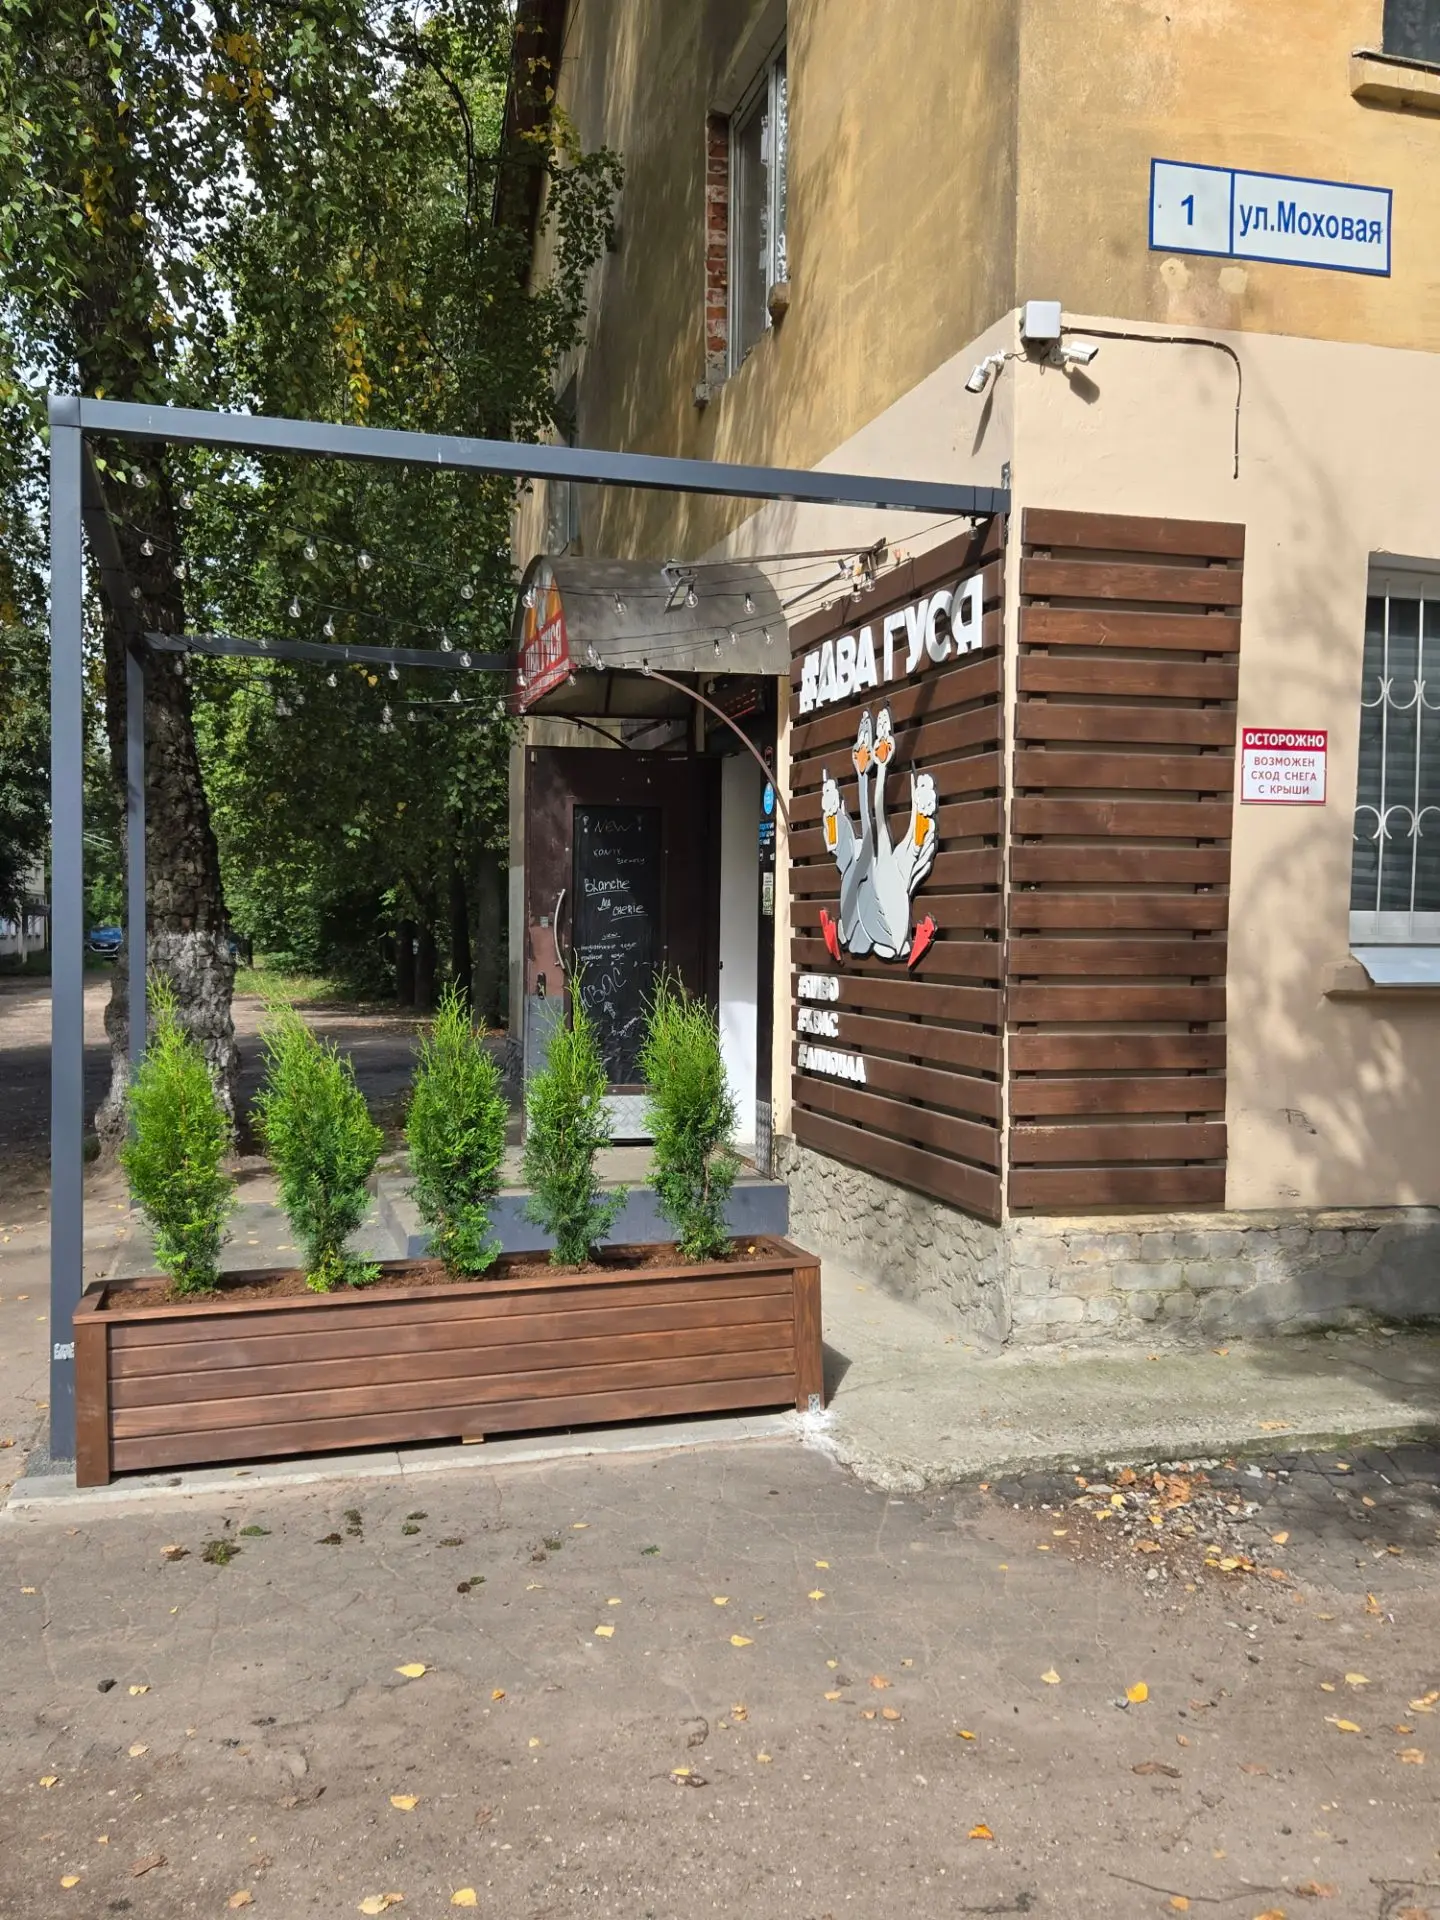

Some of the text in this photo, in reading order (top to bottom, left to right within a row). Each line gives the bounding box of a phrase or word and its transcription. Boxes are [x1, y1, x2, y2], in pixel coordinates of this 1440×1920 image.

[1180, 194, 1382, 245] 1 ул.Моховая
[883, 574, 984, 683] ГУСЯ
[1245, 733, 1325, 747] ОСТОРОЖНО
[1254, 756, 1315, 768] ВОЗМОЖЕН
[1251, 770, 1317, 782] СХОД СНЕГА
[1258, 784, 1310, 795] С КРЫШИ
